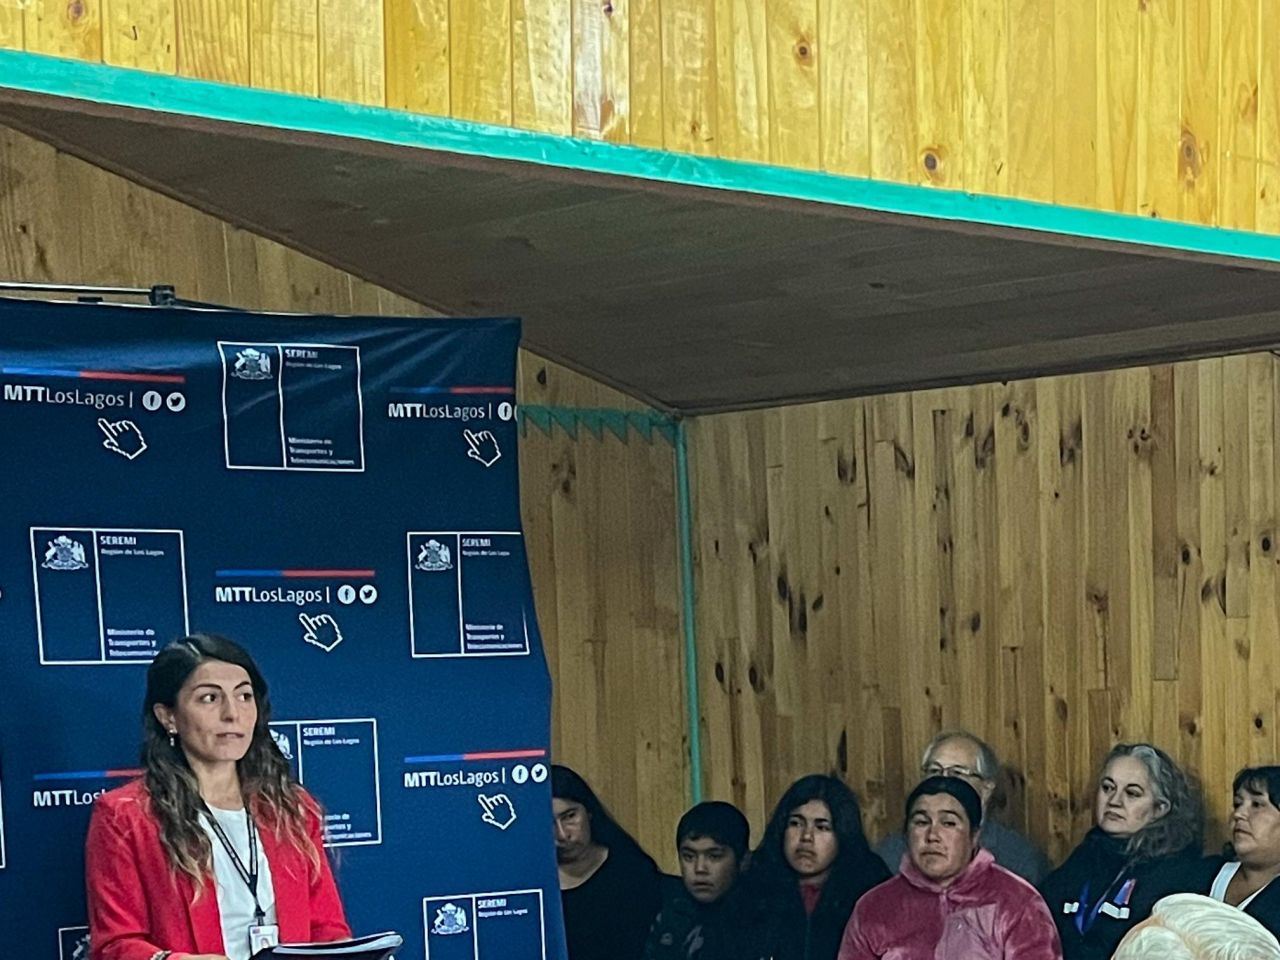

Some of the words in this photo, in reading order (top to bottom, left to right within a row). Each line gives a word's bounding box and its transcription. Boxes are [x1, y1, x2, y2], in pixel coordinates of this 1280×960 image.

[4, 384, 124, 410] MTTLosLagos
[388, 403, 485, 421] MTTLosLagos
[100, 535, 136, 546] SEREMI
[215, 586, 322, 606] MTTLosLagos
[303, 727, 335, 737] SEREMI
[404, 770, 499, 788] MTTLosLagos
